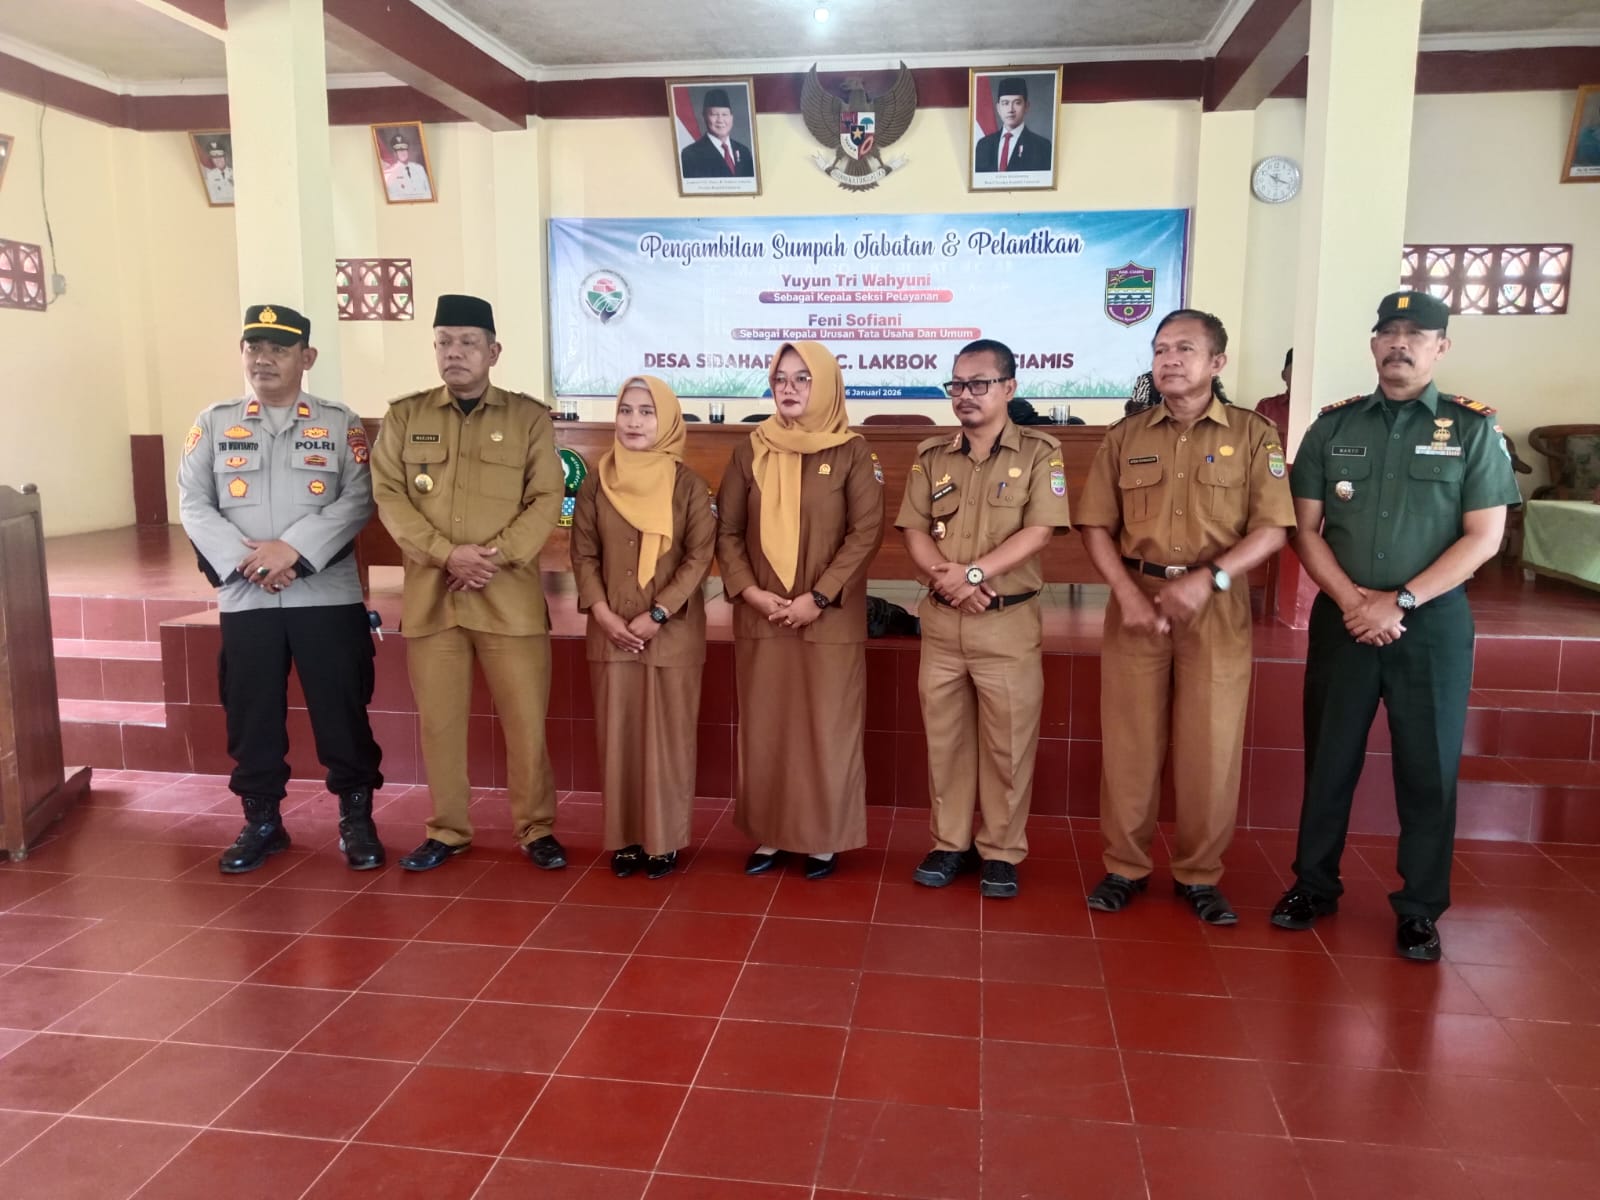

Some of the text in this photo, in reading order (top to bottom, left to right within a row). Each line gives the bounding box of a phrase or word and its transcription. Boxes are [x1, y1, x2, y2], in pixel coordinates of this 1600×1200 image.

[640, 230, 1083, 266] Pengambilan Sumpah Jabatan & Pelantikan
[781, 273, 932, 290] Yuyun Tri Wahyuni
[773, 291, 938, 303] Sebagai Kepala Seksi Pelayanan
[808, 313, 902, 327] Feni Sofiani
[739, 329, 973, 340] Sebagai Kepala Urusan Tata Usaha Dan Umum
[644, 353, 691, 368] DESA
[858, 353, 938, 370] LAKBOK
[851, 388, 882, 397] Januari
[882, 388, 902, 397] 2026
[295, 440, 335, 451] POLRI
